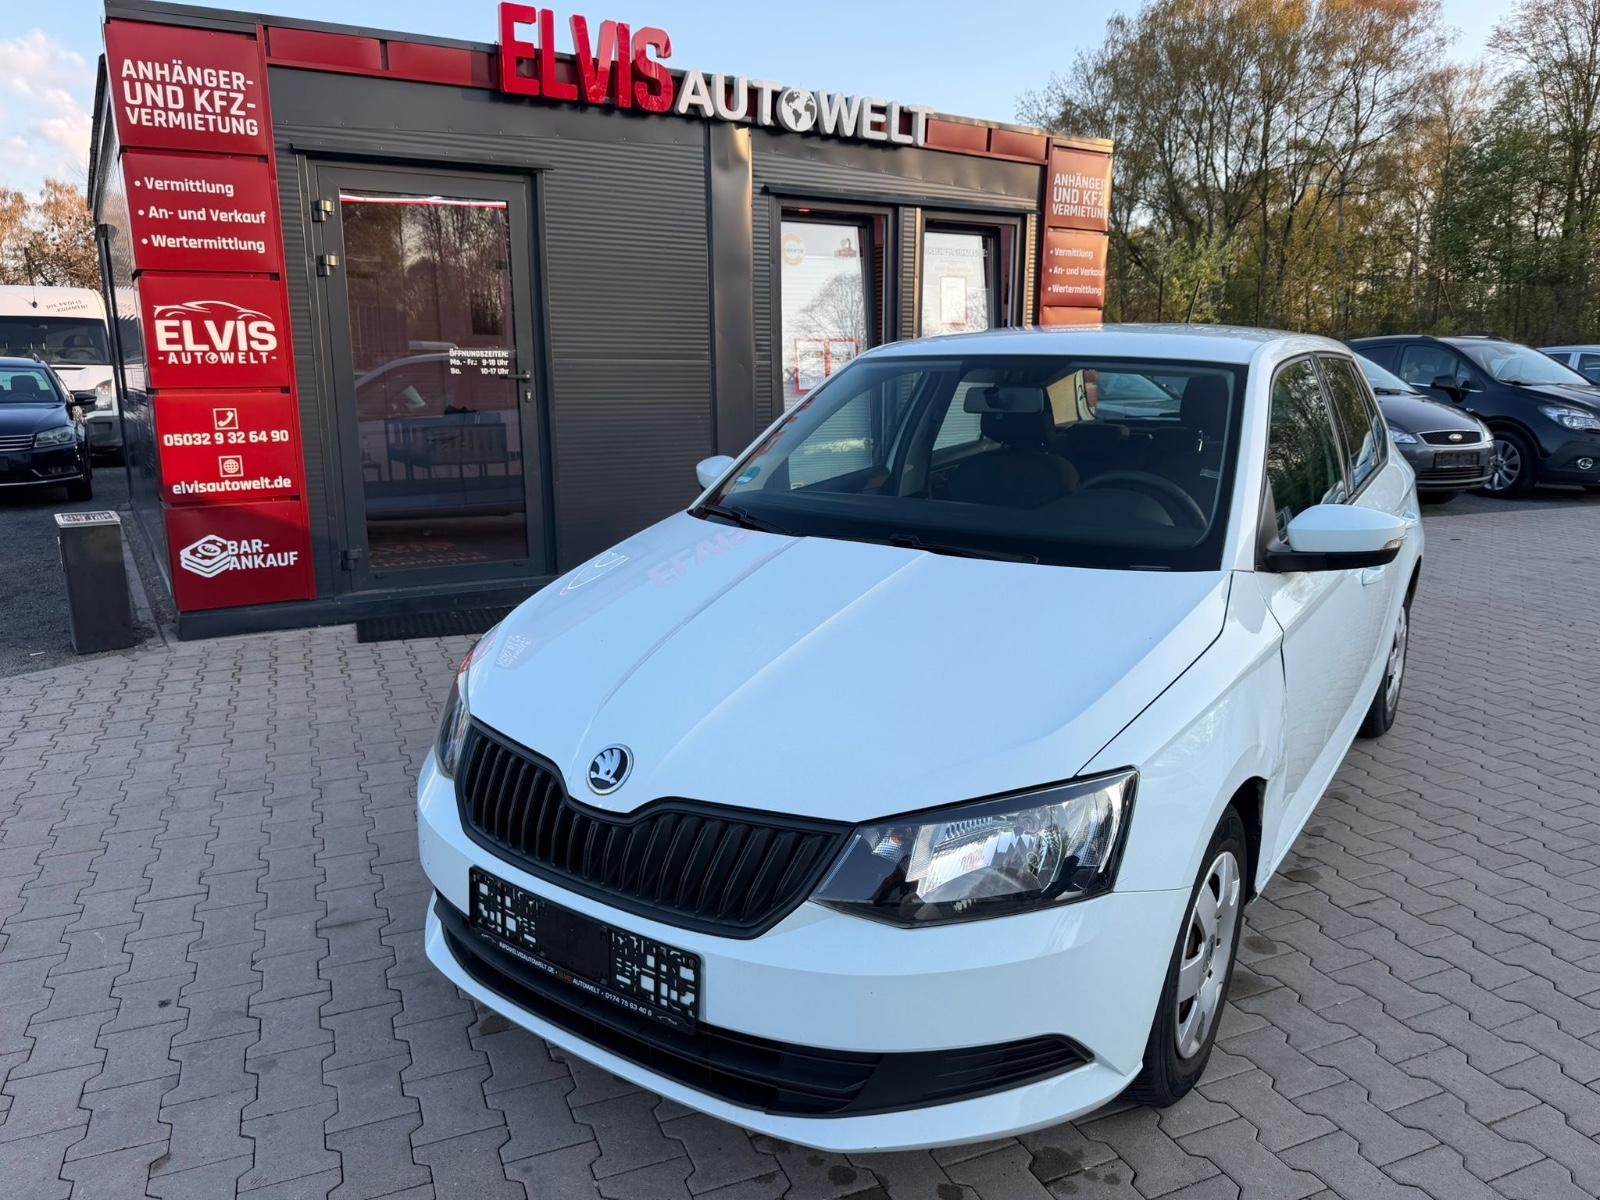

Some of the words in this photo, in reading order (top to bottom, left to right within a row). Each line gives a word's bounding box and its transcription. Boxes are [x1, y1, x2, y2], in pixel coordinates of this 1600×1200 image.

[498, 2, 673, 113] ELVIS
[122, 58, 254, 91] ANHÄNGER-
[123, 80, 184, 110] UND
[194, 88, 256, 116] KFZ-
[674, 68, 934, 147] AUTOWELT
[126, 106, 258, 136] VERMIETUNG
[144, 176, 234, 197] Vermittlung
[1054, 186, 1079, 204] UND
[149, 206, 174, 219] An-
[178, 207, 206, 220] und
[210, 209, 266, 224] Verkauf
[151, 234, 265, 253] Wertermittlung
[1054, 247, 1094, 260] Vermittlung
[1053, 266, 1064, 276] An-
[1066, 266, 1079, 276] und
[1052, 283, 1102, 296] Wertermittlung
[155, 320, 278, 351] ELVIS
[449, 348, 508, 358] ÖFFNUNGSZEITEN:
[164, 432, 211, 446] 05032
[214, 432, 224, 444] 9
[228, 432, 245, 443] 32
[250, 431, 268, 443] 64
[271, 430, 289, 442] 90
[172, 476, 292, 494] elvisautowelt.de
[227, 538, 270, 554] BAR-
[228, 551, 298, 571] ANKAUF
[572, 978, 600, 994] AUTOWELT
